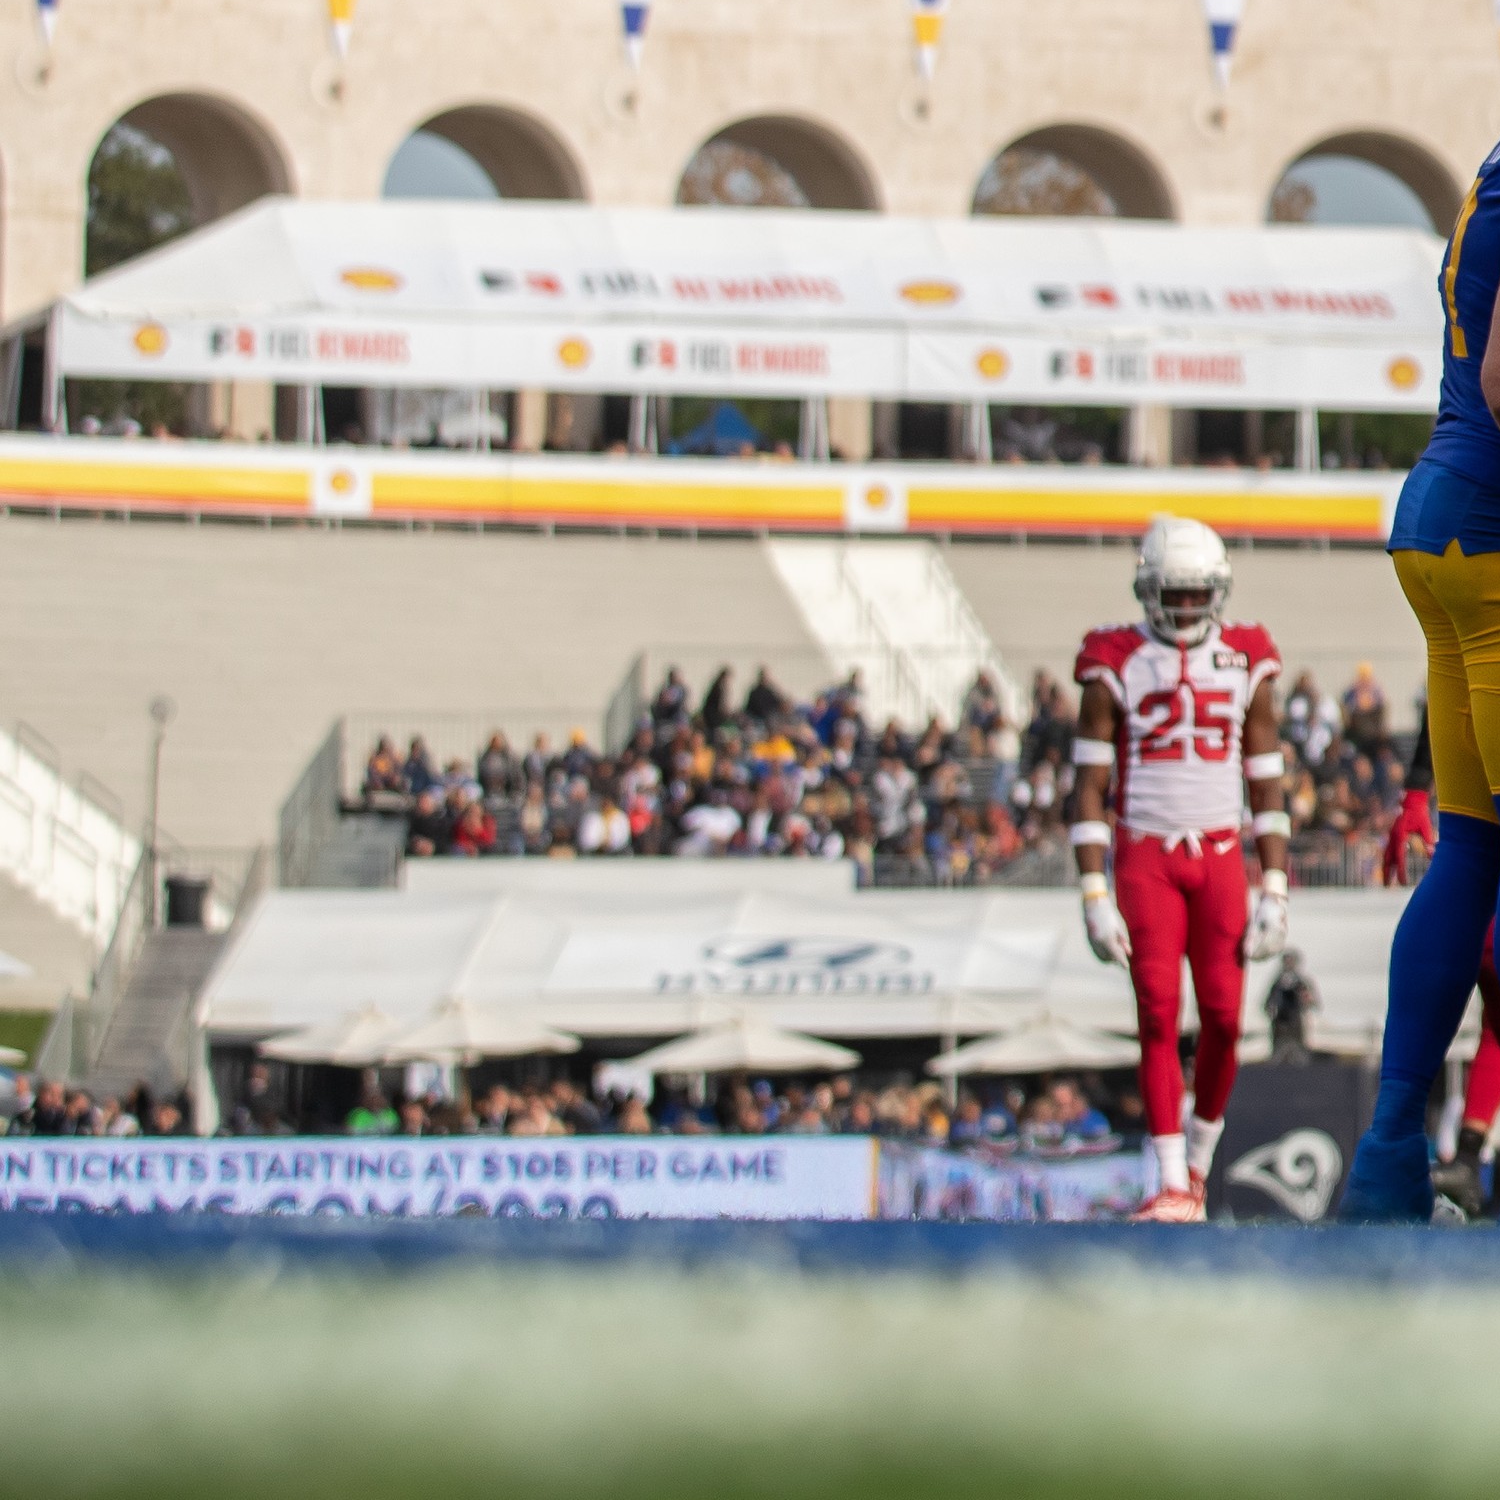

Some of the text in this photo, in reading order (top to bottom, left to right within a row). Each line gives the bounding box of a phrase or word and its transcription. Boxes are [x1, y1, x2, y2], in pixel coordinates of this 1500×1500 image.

[1139, 689, 1234, 763] 25
[43, 1150, 209, 1183] TICKETS
[219, 1150, 414, 1183] STARTING
[424, 1151, 471, 1182] AT
[584, 1151, 658, 1182] PER
[667, 1149, 786, 1183] GAME
